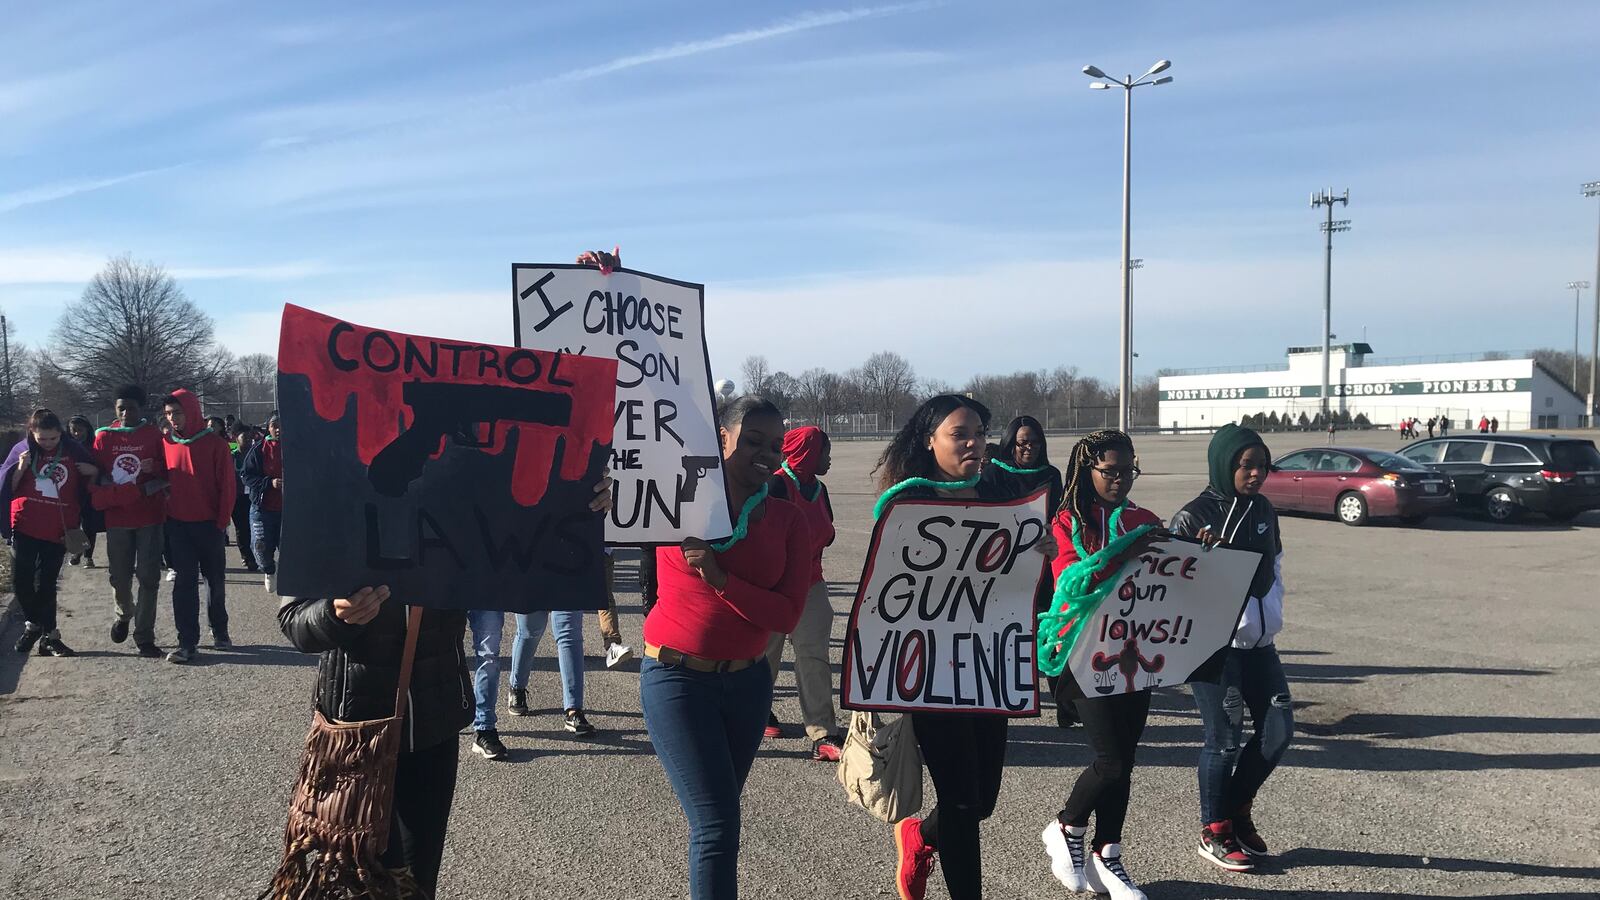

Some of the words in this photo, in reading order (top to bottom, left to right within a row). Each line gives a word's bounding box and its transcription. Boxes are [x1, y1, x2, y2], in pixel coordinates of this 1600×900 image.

[520, 271, 574, 332] I
[583, 290, 684, 339] CHOOSE
[327, 322, 574, 387] CONTROL
[1167, 388, 1246, 400] NORTHWEST
[1267, 386, 1301, 397] HIGH
[1334, 383, 1393, 396] SCHOOL
[1422, 379, 1517, 393] PIONEERS
[610, 449, 643, 470] HE
[604, 474, 683, 529] UN
[364, 502, 597, 575] LAWS
[902, 515, 1044, 575] STOP
[878, 573, 996, 623] GUN
[1118, 579, 1167, 617] gun
[1100, 614, 1193, 645] laws!!
[852, 622, 1034, 711] VIOLENCE
